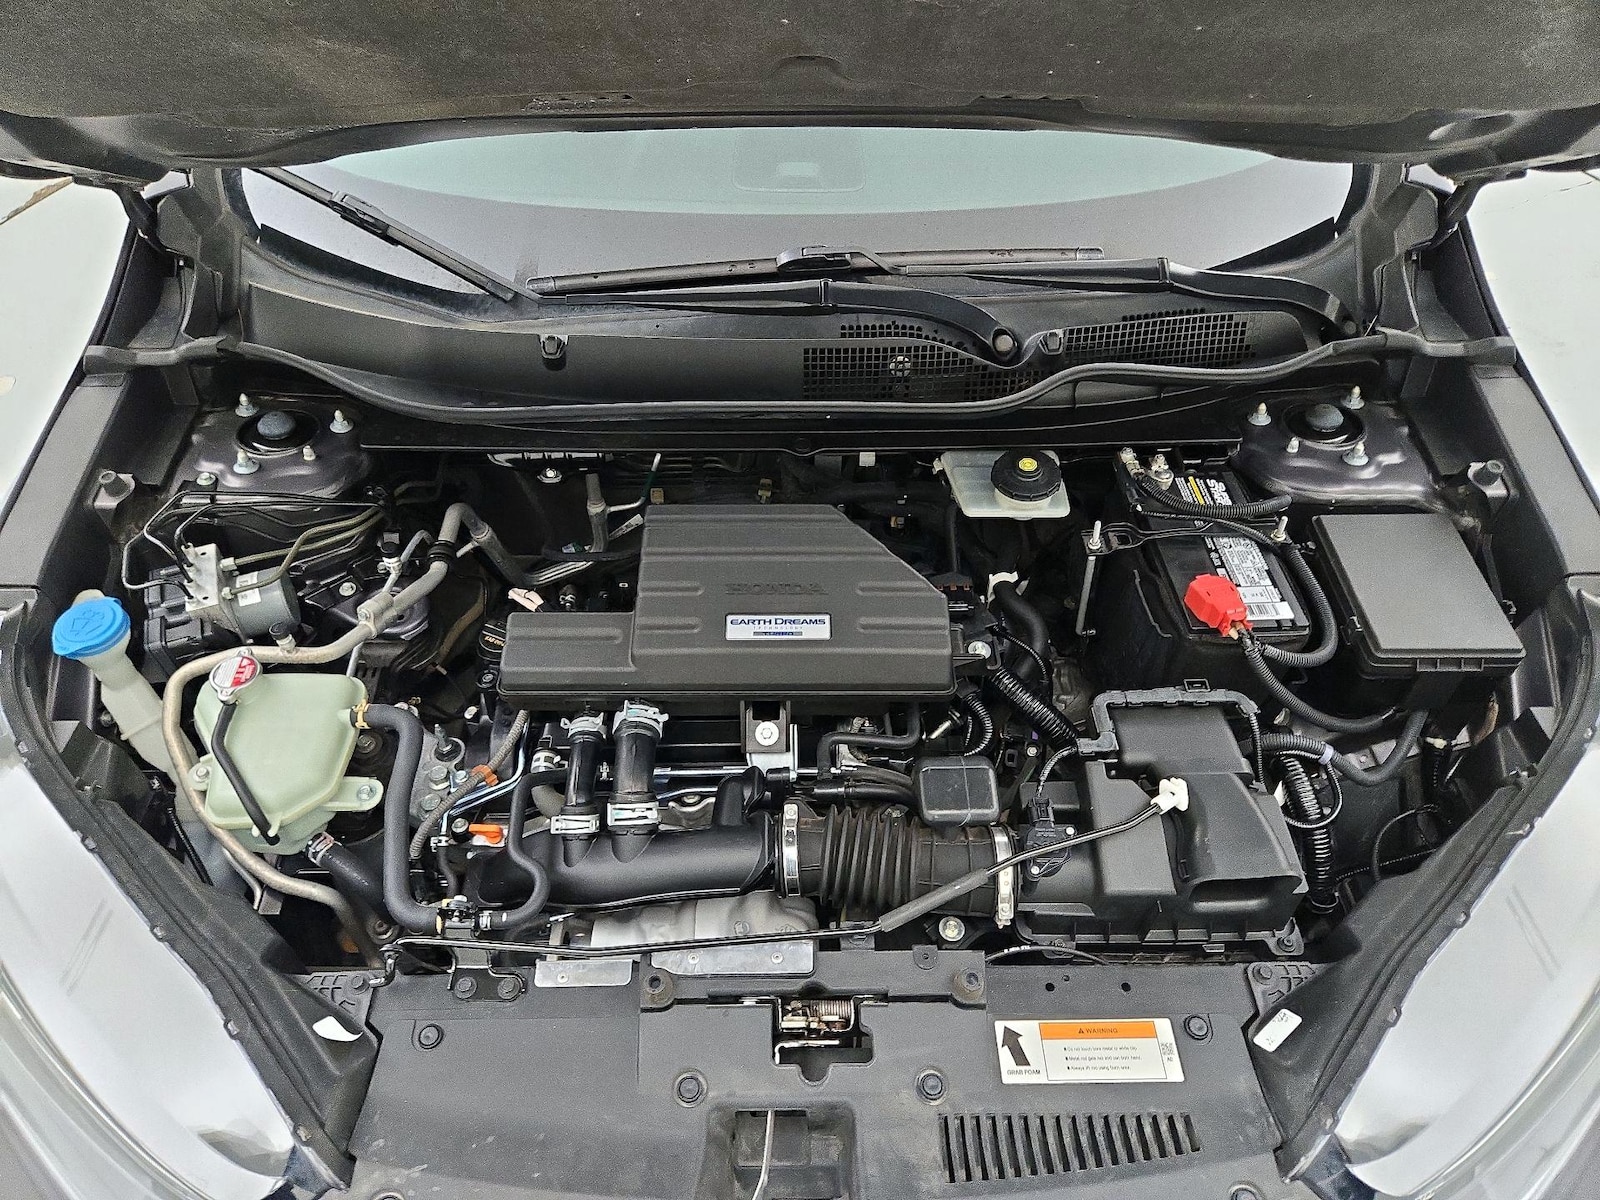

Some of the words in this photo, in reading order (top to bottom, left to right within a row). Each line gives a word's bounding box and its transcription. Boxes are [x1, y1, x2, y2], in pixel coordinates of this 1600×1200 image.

[724, 583, 830, 596] HONDA
[730, 618, 772, 626] EARTH
[774, 617, 826, 626] DREAMS
